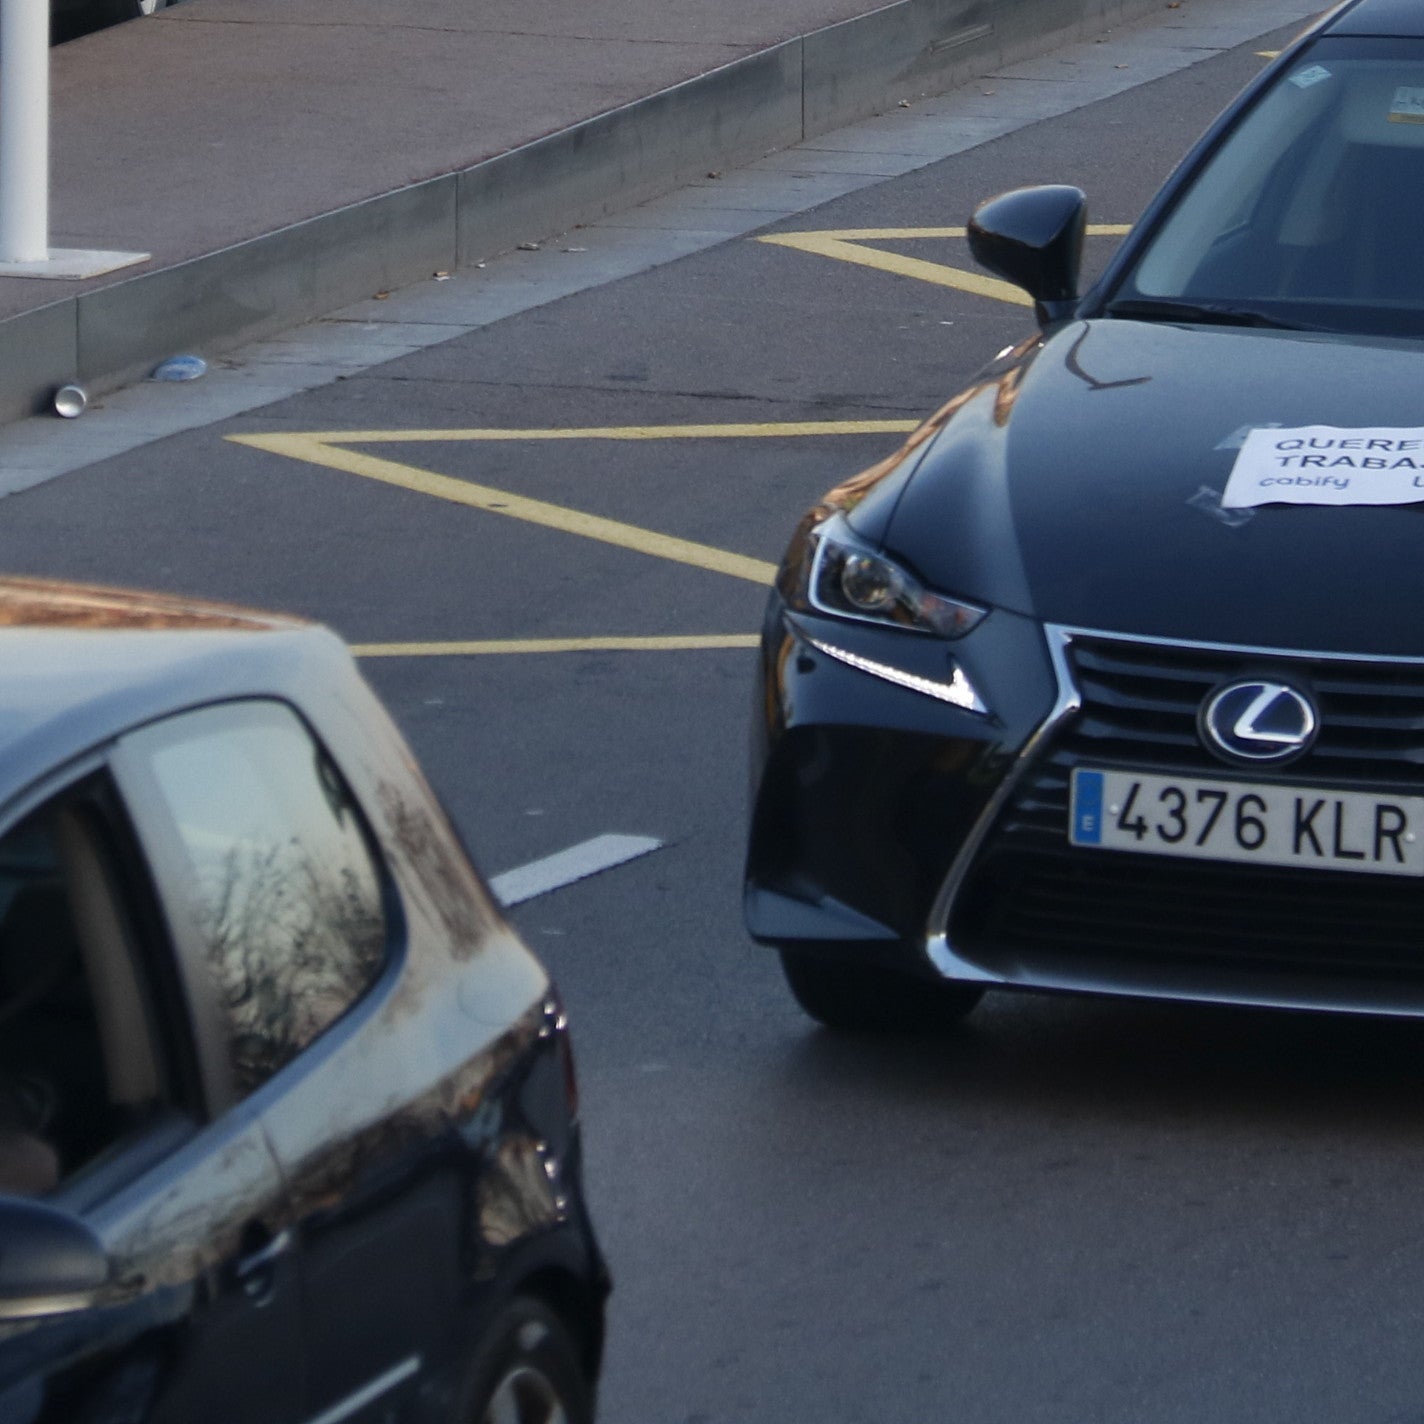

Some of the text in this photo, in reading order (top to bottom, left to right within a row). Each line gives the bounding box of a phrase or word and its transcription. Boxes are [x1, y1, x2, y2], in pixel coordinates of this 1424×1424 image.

[1258, 475, 1351, 491] cabify
[1116, 782, 1268, 851] 4376
[1292, 796, 1408, 864] KLR
